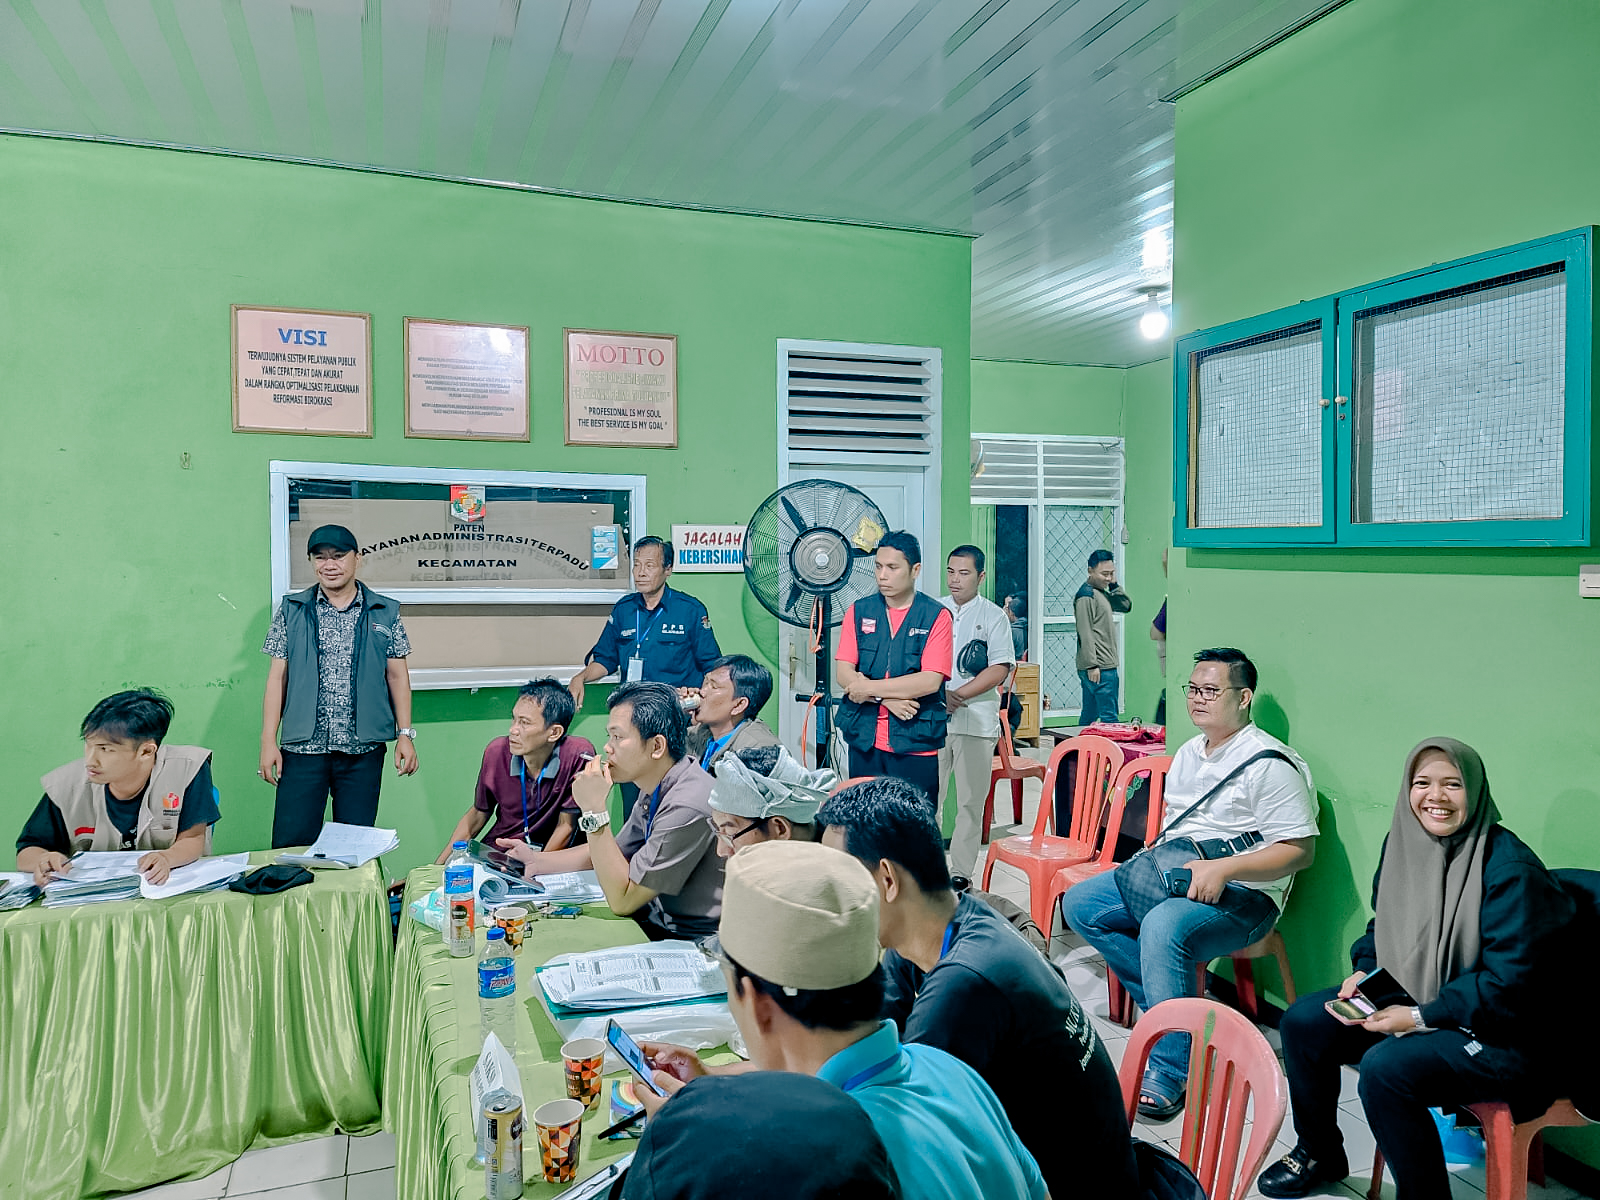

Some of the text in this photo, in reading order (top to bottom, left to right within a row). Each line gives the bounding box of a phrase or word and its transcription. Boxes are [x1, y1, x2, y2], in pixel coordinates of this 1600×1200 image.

[278, 328, 328, 346] VISI
[248, 351, 356, 366] TERWUJUDNYA SISTEM PELAYANAN PUBLIK
[576, 344, 665, 366] MOTTO
[262, 366, 276, 375] YANG
[311, 368, 322, 378] DAN
[323, 369, 343, 379] AKURAT
[244, 378, 360, 393] DALAM RANGKA OPTIMALISASI PELAKSANAAN
[273, 393, 333, 406] REFORMASI BIROKRASI
[588, 407, 628, 417] PROFESIONAL
[629, 409, 636, 417] IS
[637, 409, 646, 417] MY
[647, 410, 662, 418] SOUL
[578, 418, 590, 427] THE
[591, 419, 605, 427] BEST
[606, 420, 631, 429] SERVICE
[632, 421, 638, 429] IS
[638, 421, 647, 429] MY
[649, 422, 664, 430] GOAL
[454, 524, 485, 532] PATEN
[360, 533, 420, 556] AYANAN
[684, 531, 742, 546] JAGALAH
[417, 559, 517, 568] KECAMATAN
